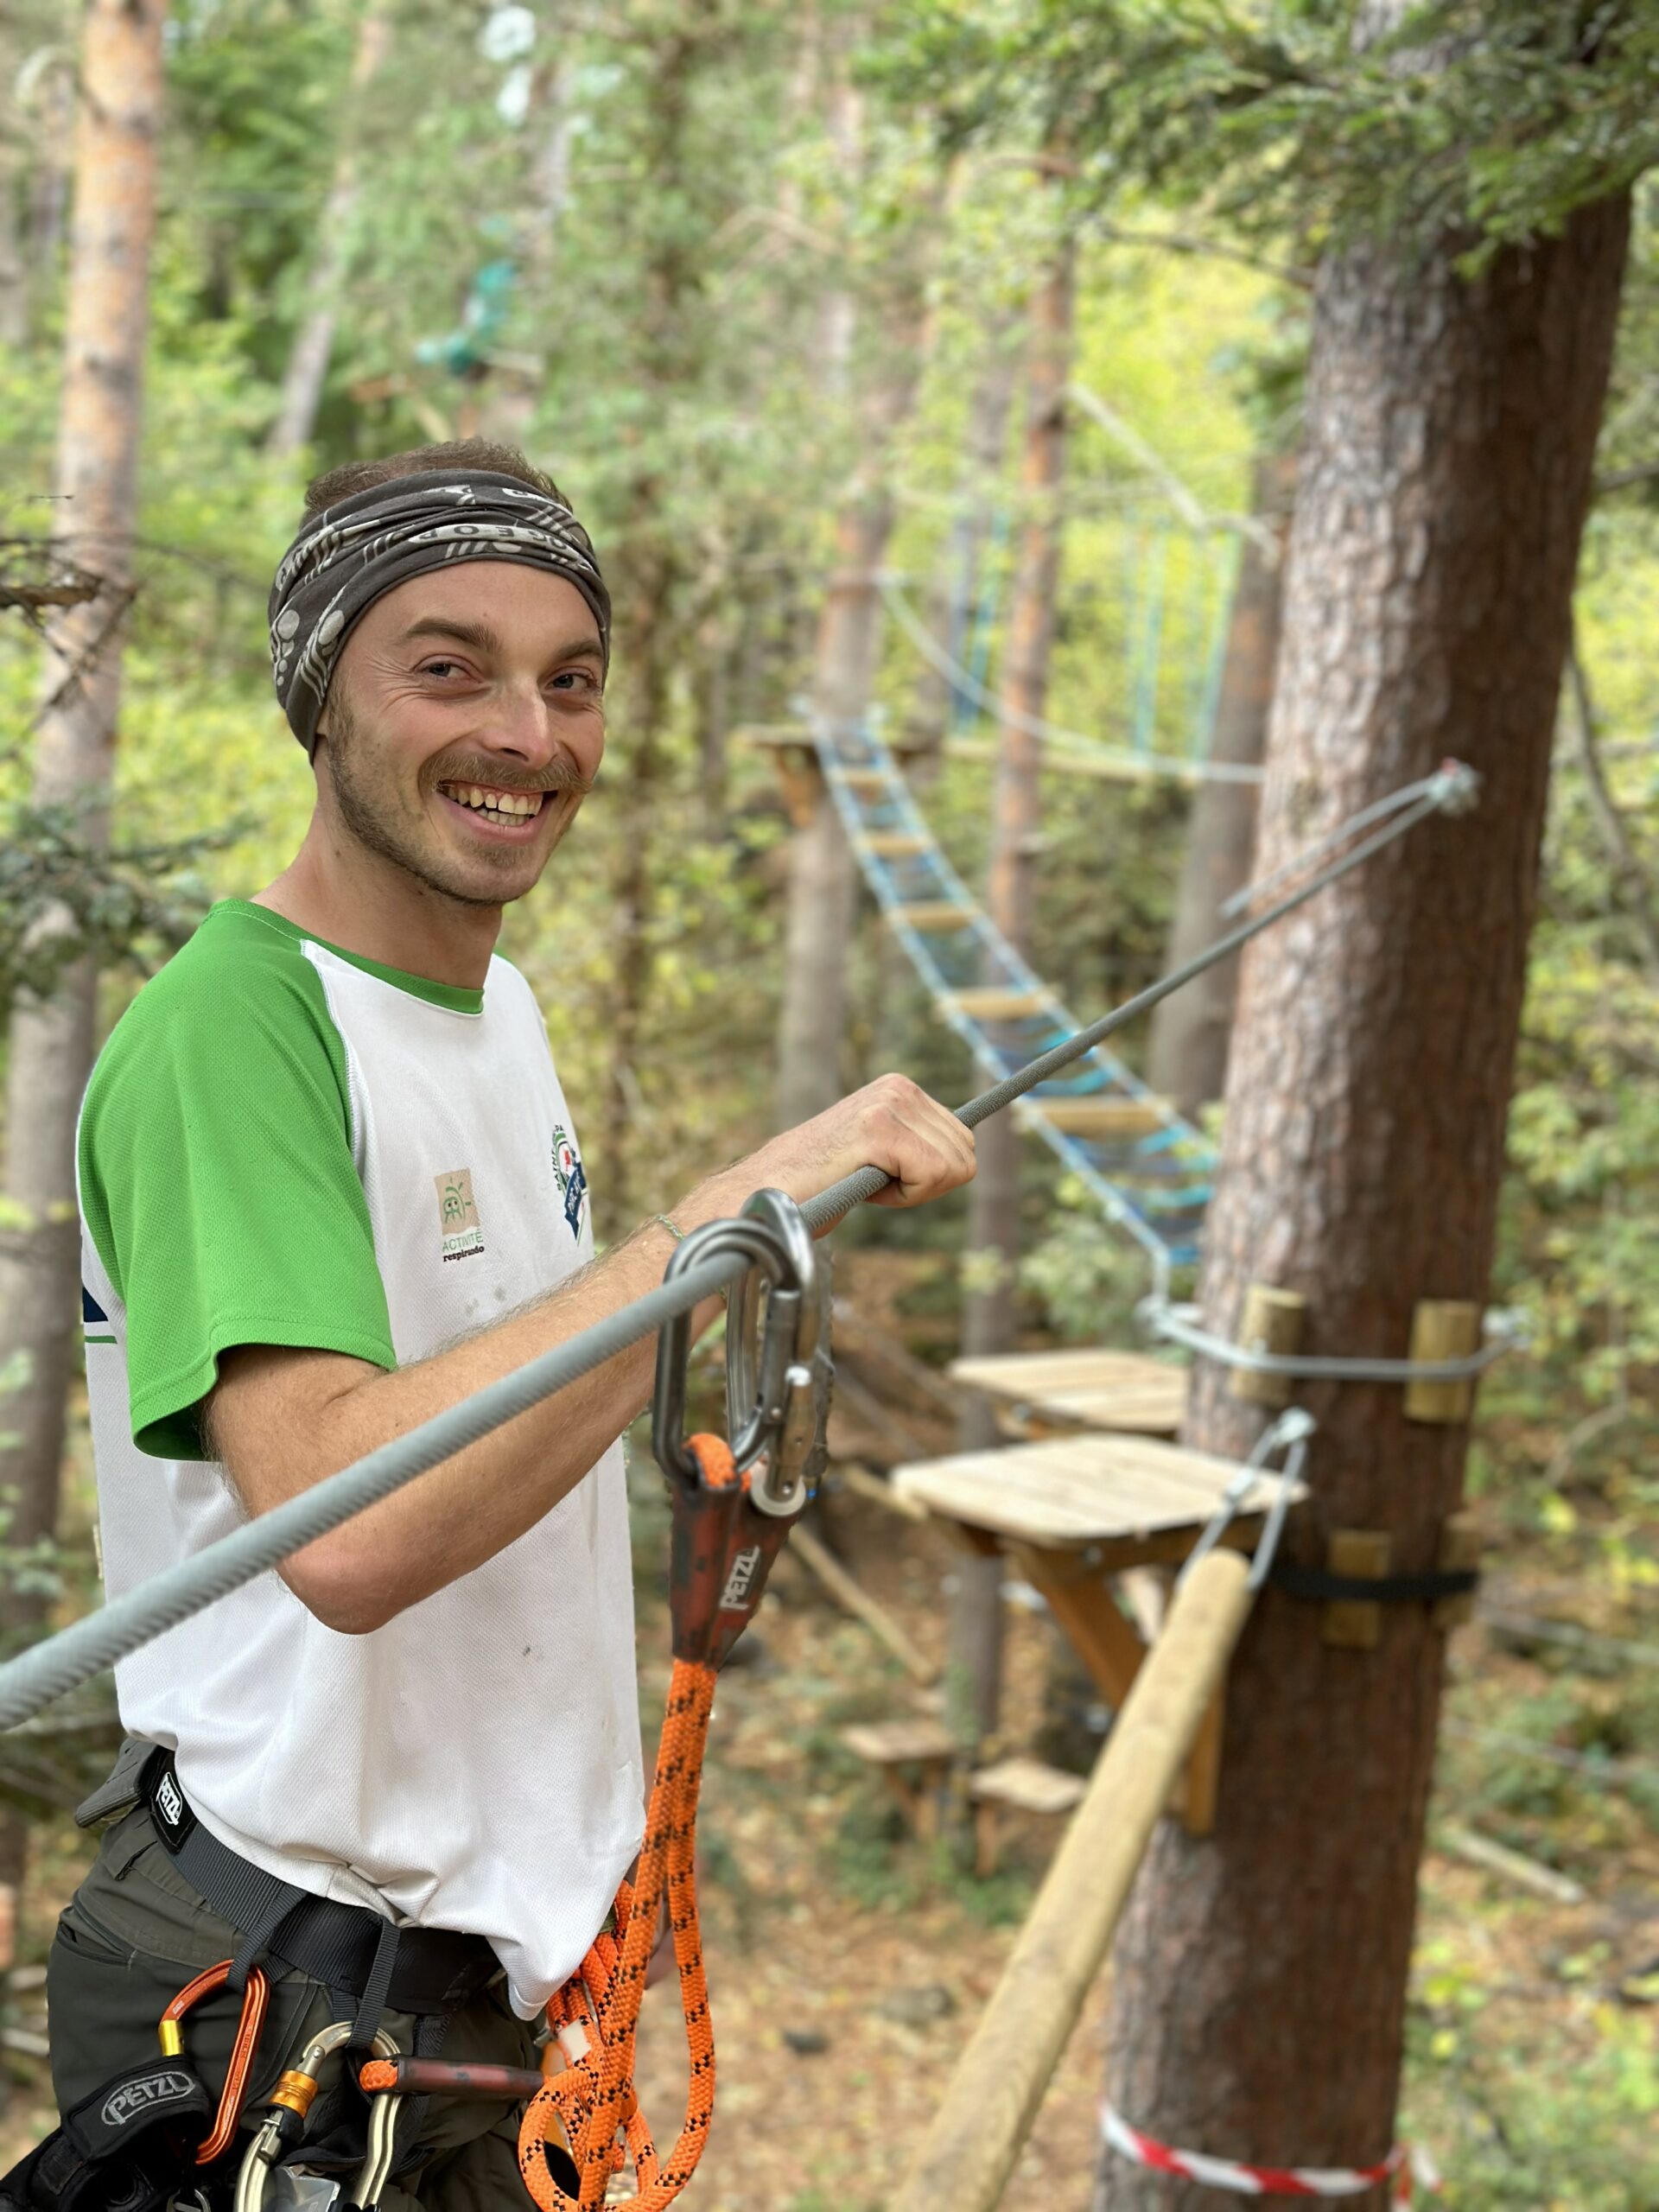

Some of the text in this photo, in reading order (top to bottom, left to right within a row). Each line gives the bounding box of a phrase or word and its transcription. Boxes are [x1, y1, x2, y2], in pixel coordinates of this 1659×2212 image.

[719, 1545, 760, 1611] PETZL
[156, 1772, 181, 1826] PETZL
[107, 2074, 196, 2126] PETZL
